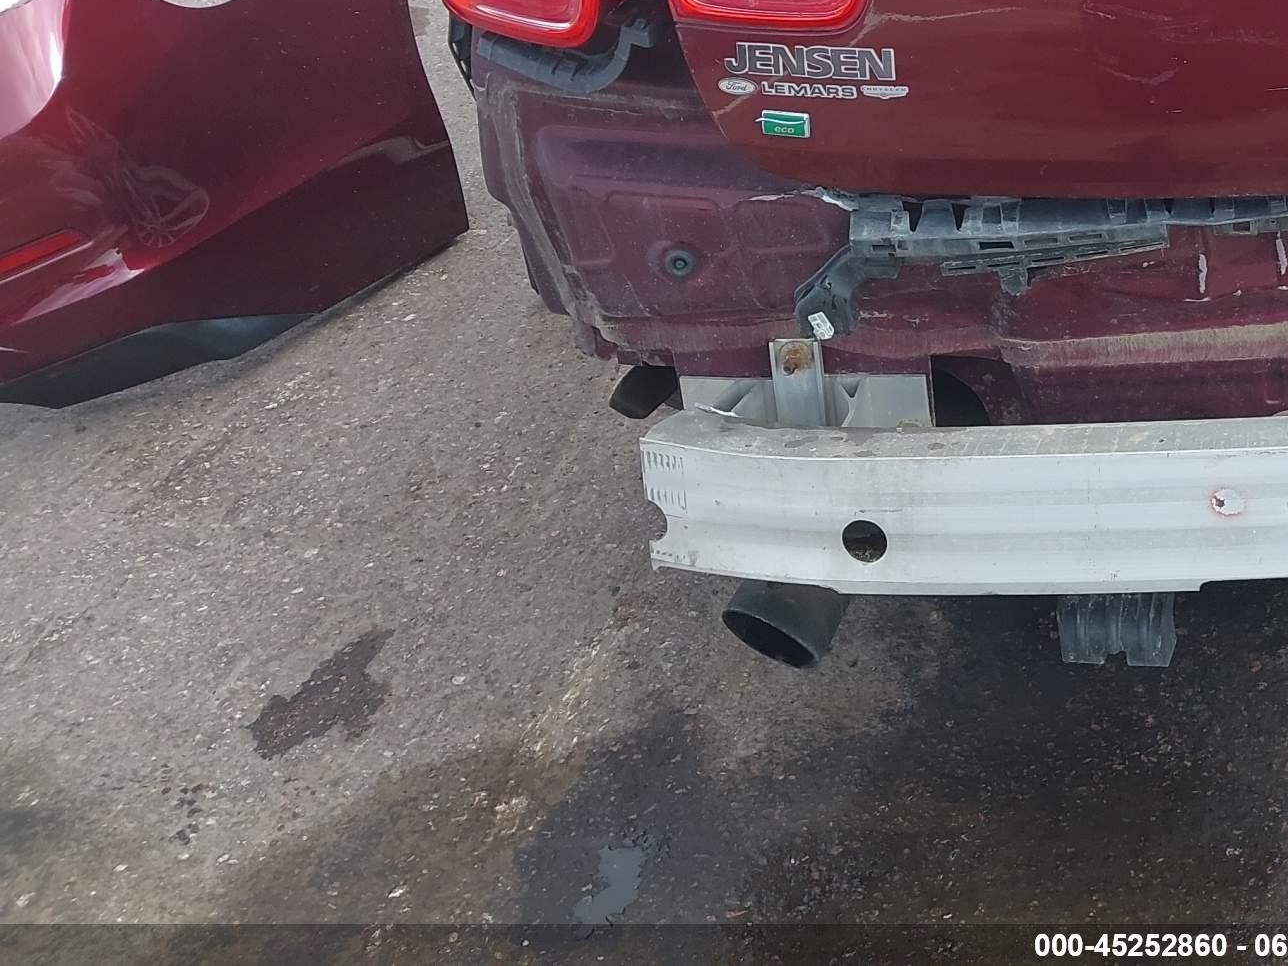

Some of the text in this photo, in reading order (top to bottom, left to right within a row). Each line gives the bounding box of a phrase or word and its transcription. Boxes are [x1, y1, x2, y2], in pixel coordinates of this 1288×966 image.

[724, 42, 896, 81] JENSEN
[726, 82, 748, 91] Ford
[762, 82, 857, 99] LEMARS
[774, 126, 795, 134] eco
